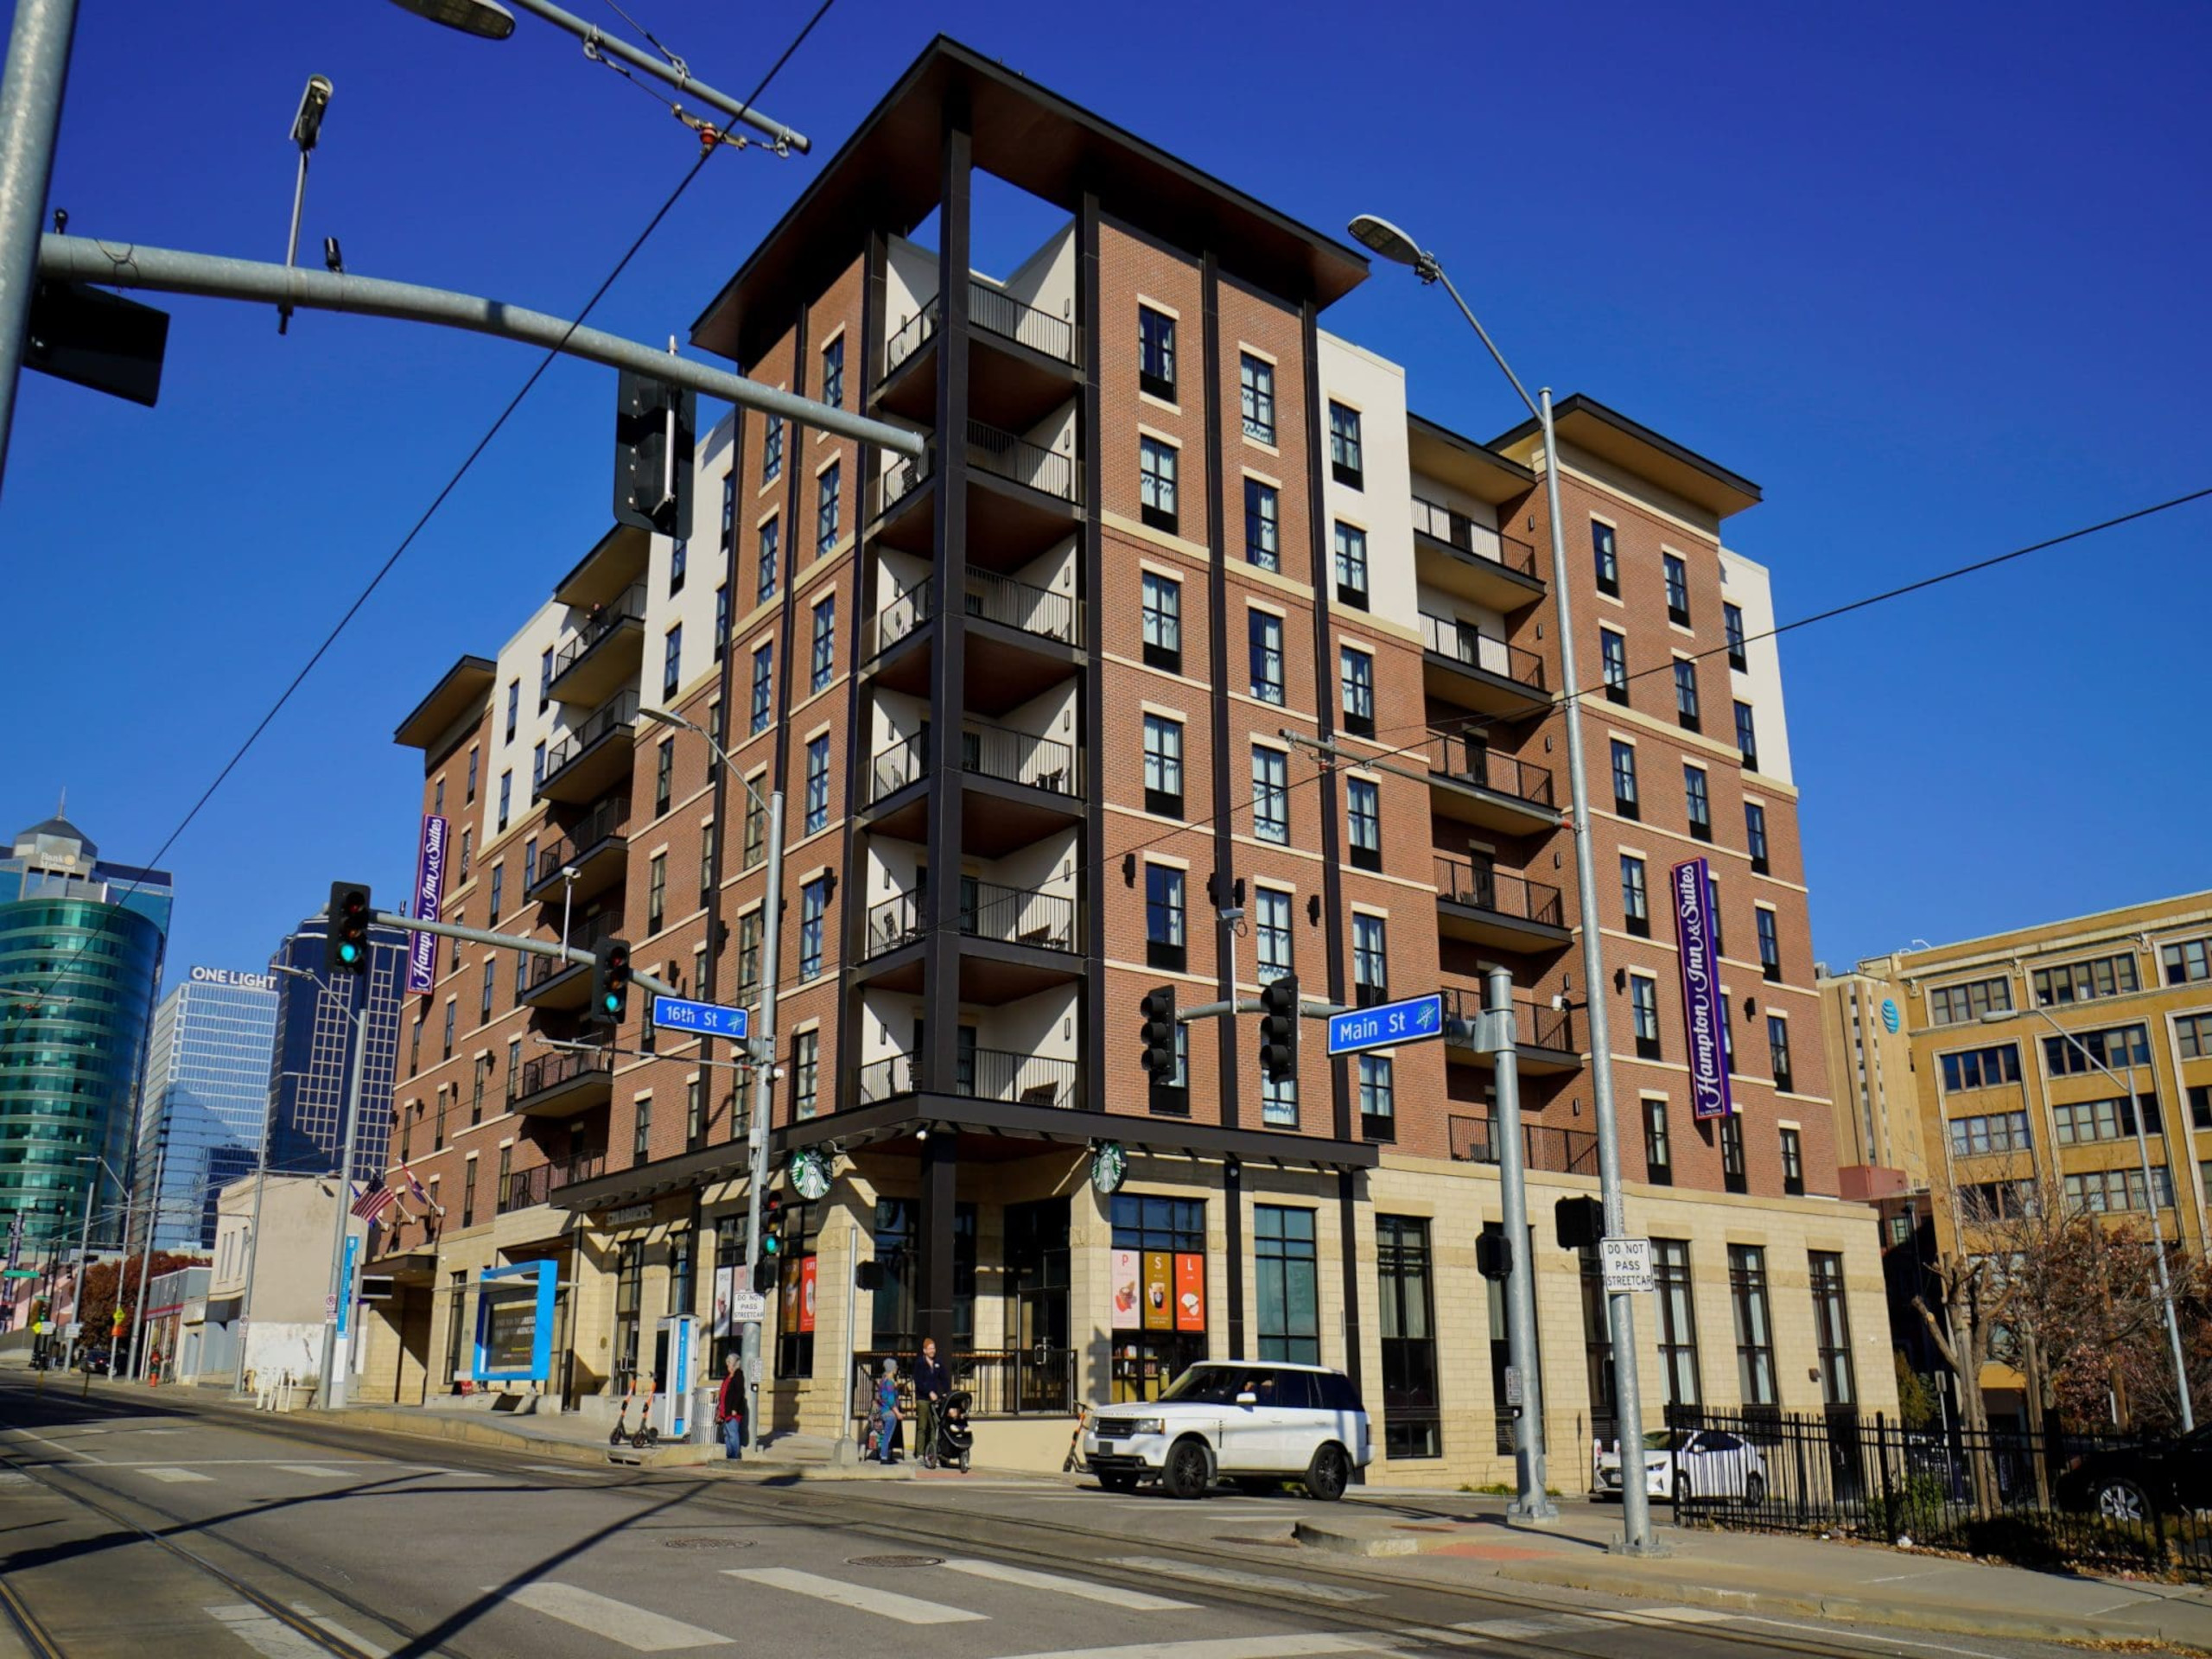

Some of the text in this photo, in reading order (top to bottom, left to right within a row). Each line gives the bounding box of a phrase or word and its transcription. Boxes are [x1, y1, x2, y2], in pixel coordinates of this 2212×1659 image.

[425, 817, 442, 860] Suites
[422, 867, 438, 908] Inn
[1681, 864, 1700, 925] Suites
[412, 907, 435, 988] Hampn
[1687, 937, 1708, 993] Inn
[192, 966, 277, 989] ONE LIGHT
[666, 1005, 718, 1027] 16th St
[1340, 1011, 1406, 1043] Main St
[1693, 995, 1722, 1109] Hampton
[1122, 1254, 1128, 1267] P
[1608, 1244, 1643, 1255] DO NOT
[1154, 1256, 1162, 1269] S
[1187, 1258, 1193, 1271] L
[1615, 1261, 1641, 1271] PASS
[1608, 1275, 1651, 1287] STREETCAR
